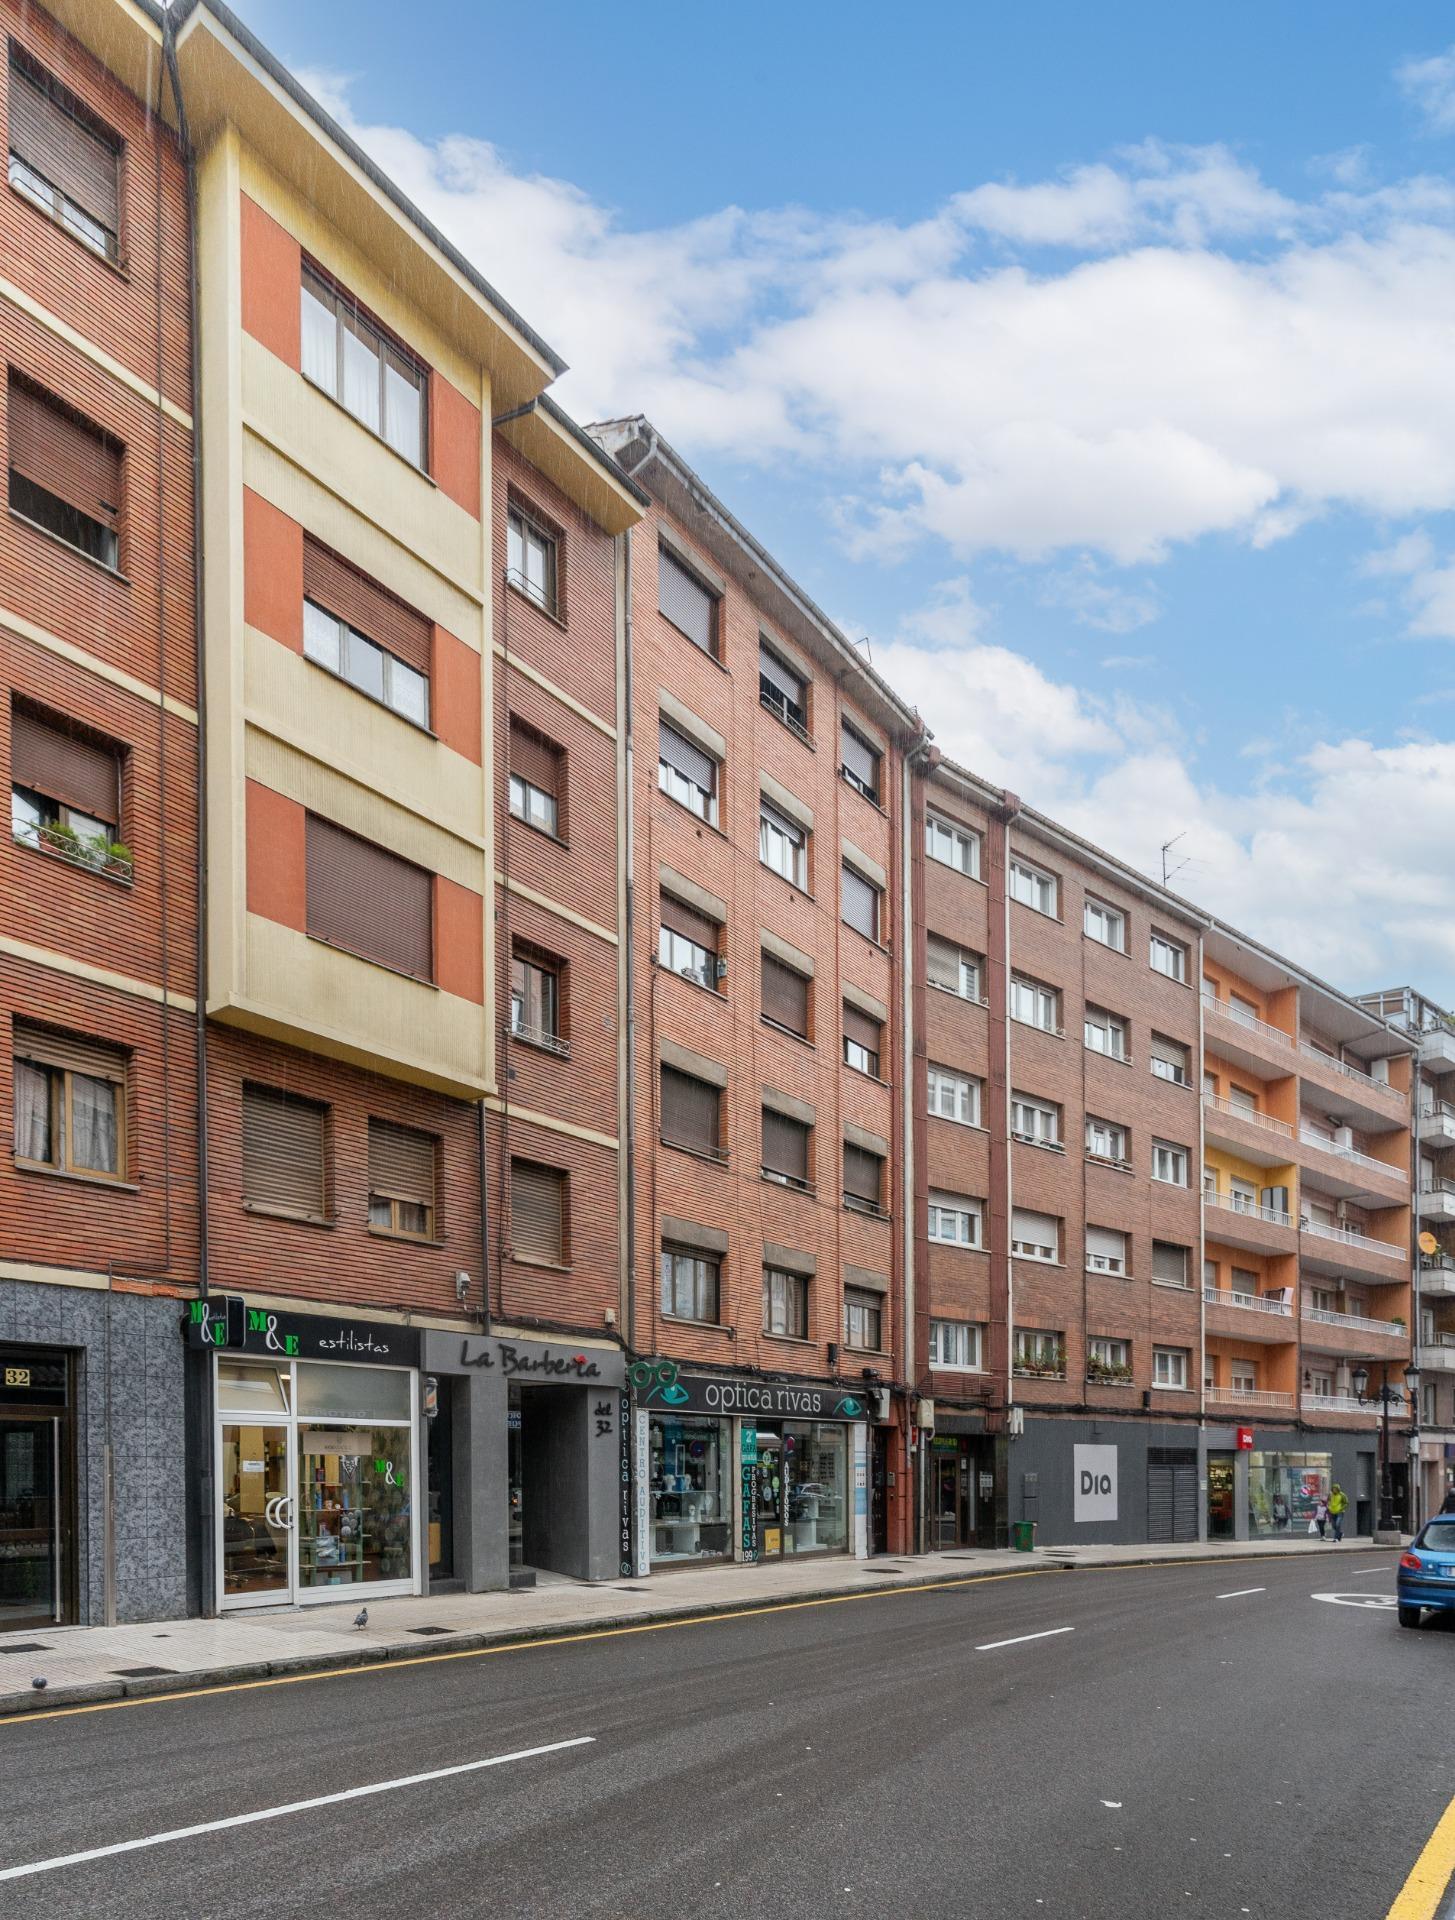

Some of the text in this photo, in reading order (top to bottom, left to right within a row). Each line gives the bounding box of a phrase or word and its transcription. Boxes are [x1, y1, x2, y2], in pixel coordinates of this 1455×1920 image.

[248, 1310, 390, 1355] M&E estilistas
[460, 1340, 495, 1368] La
[7, 1369, 29, 1384] 32
[594, 1401, 613, 1416] del
[705, 1382, 821, 1414] optica rivas
[595, 1419, 613, 1437] 32
[621, 1399, 630, 1552] optica rivas
[742, 1466, 751, 1548] GAFAS
[1364, 1596, 1398, 1606] 3
